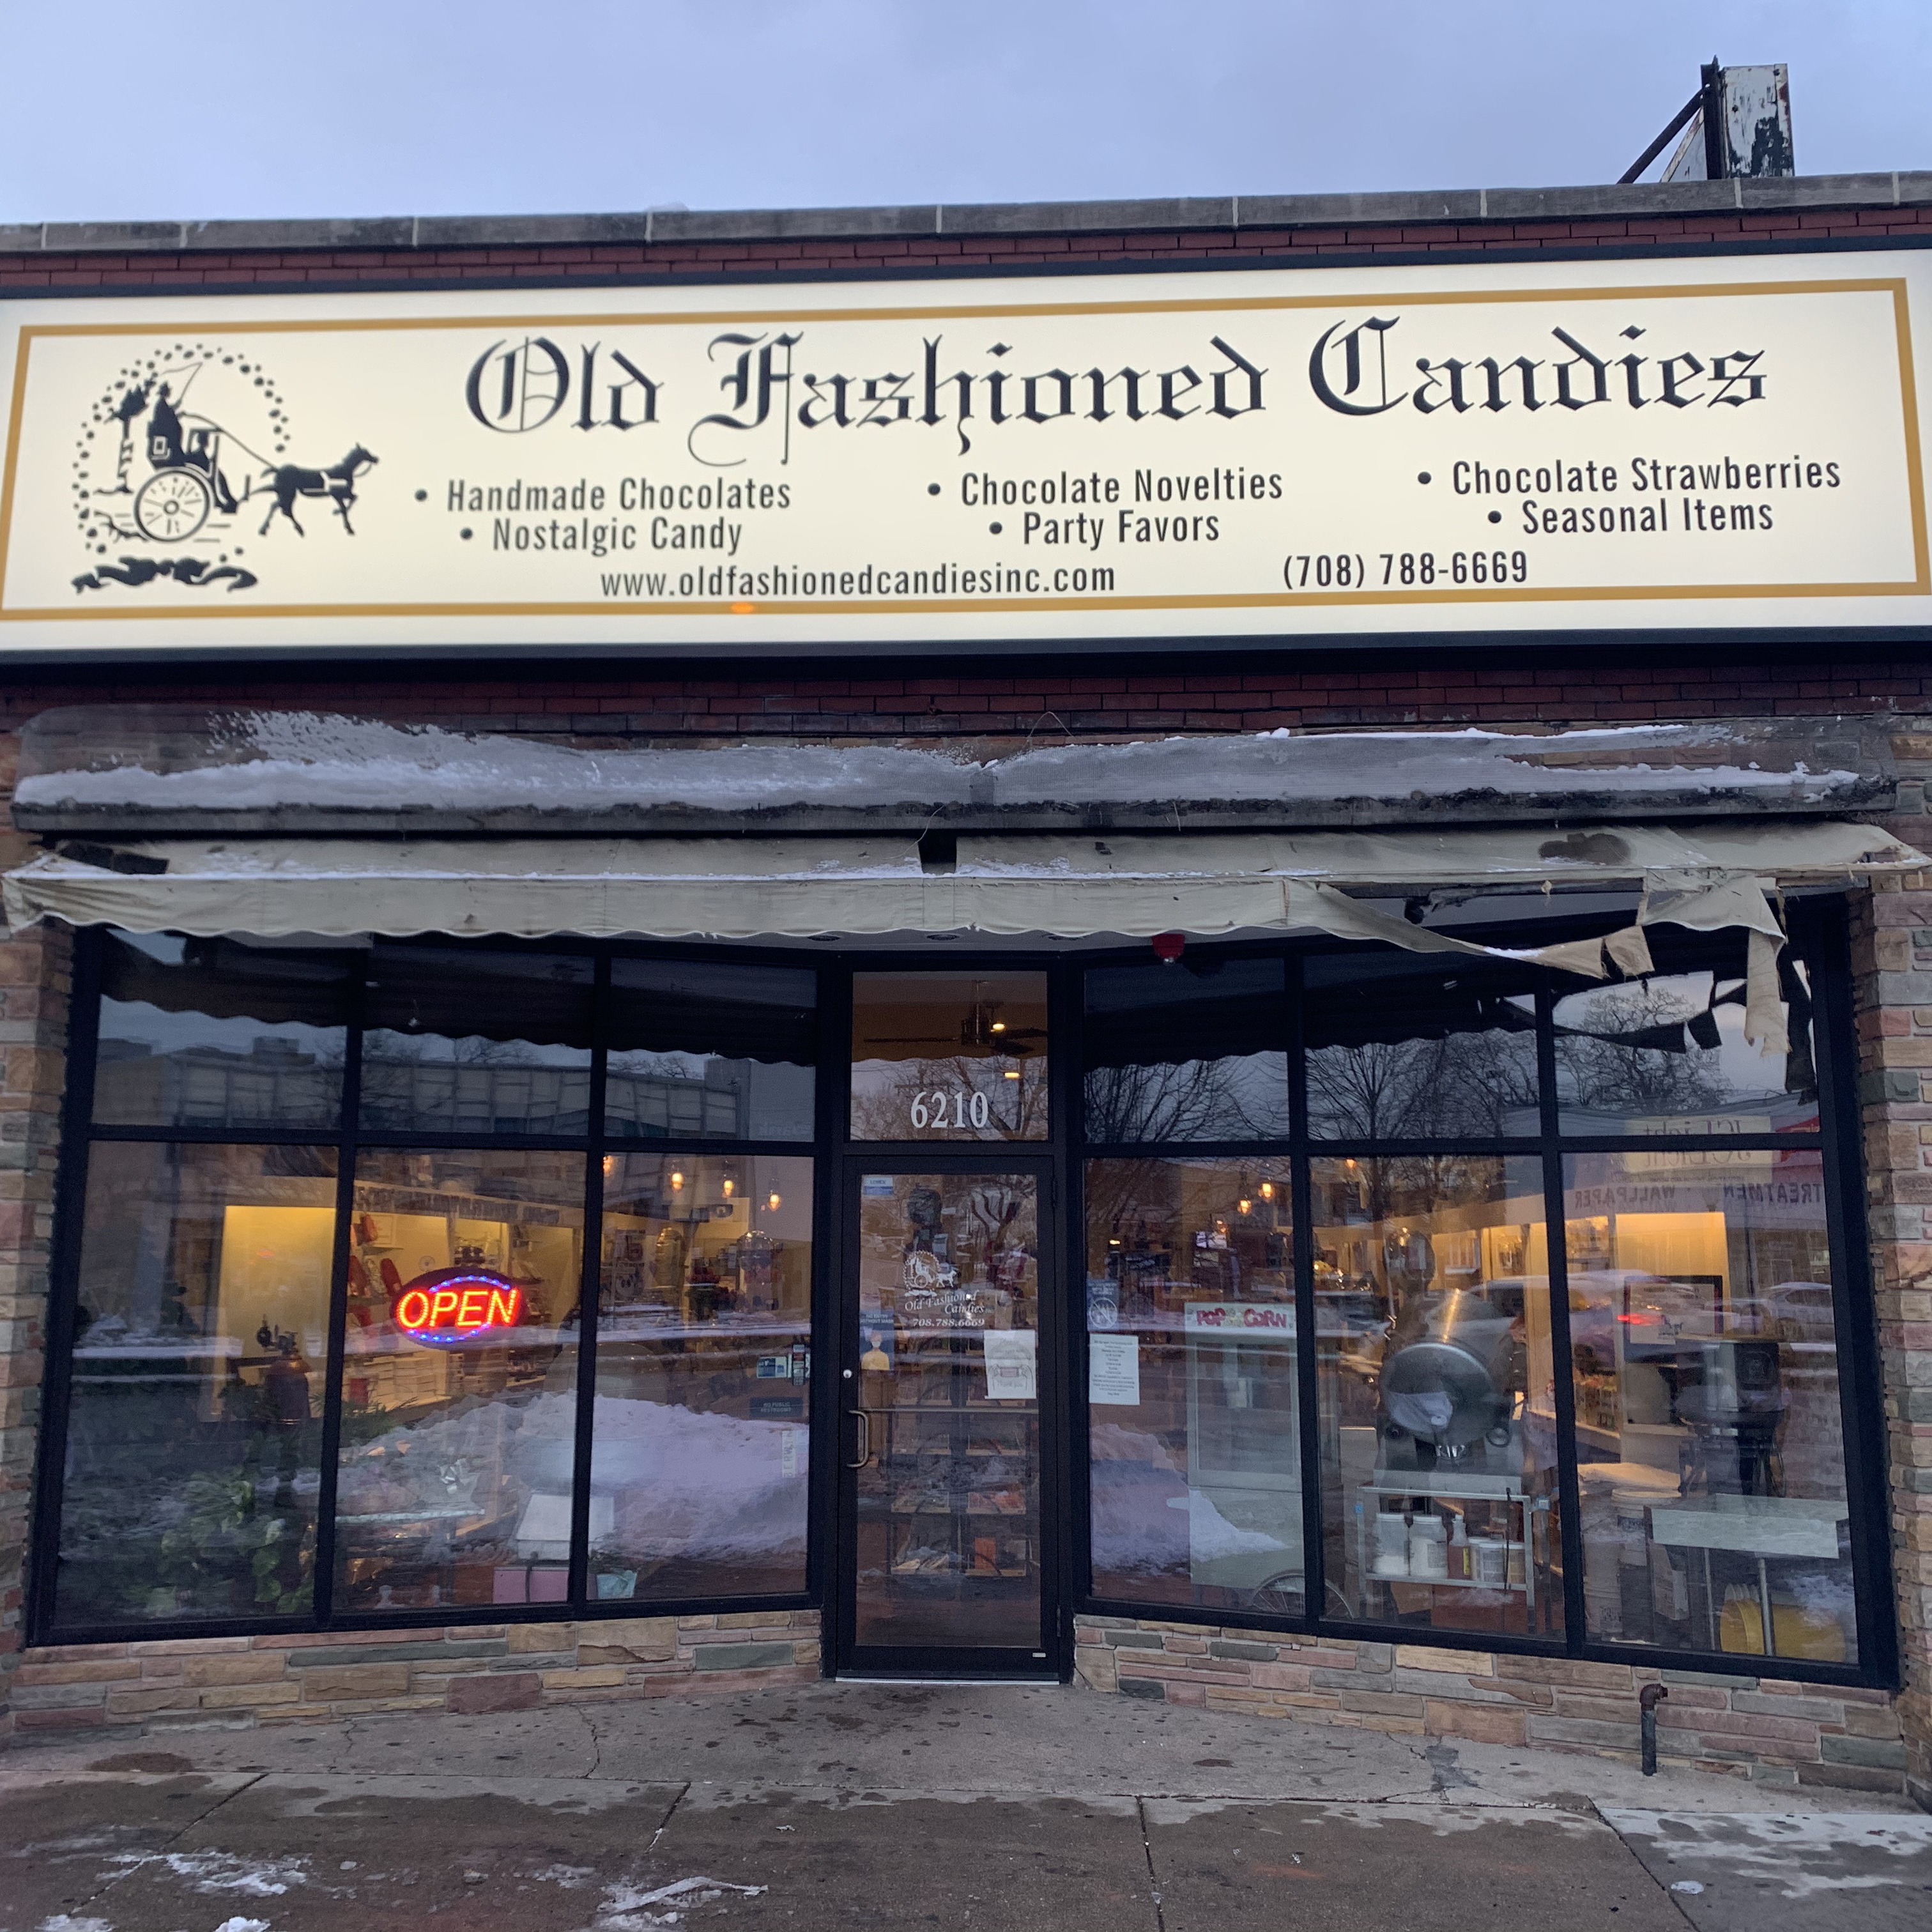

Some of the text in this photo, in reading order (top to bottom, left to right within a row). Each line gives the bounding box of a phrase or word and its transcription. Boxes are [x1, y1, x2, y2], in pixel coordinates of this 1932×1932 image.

[466, 316, 1767, 467] Old Fashioned Candies
[962, 467, 1282, 506] Chocolate Novelties
[1453, 455, 1840, 494] Chocolate Strawberries
[448, 477, 790, 511] Handmade Chocolates
[1024, 510, 1218, 551] Party Favors
[1522, 498, 1772, 534] Seasonal Items
[494, 517, 741, 556] Nostalgic Candy
[601, 565, 1114, 597] www.oldfashionedcandiesinc.com
[1283, 551, 1528, 590] (708) 788-6669
[910, 1091, 988, 1128] 6210
[396, 1287, 520, 1328] OPEN
[905, 1298, 924, 1312] Old
[913, 1317, 985, 1326] 708.788.6669
[1197, 1308, 1287, 1328] POP CORN
